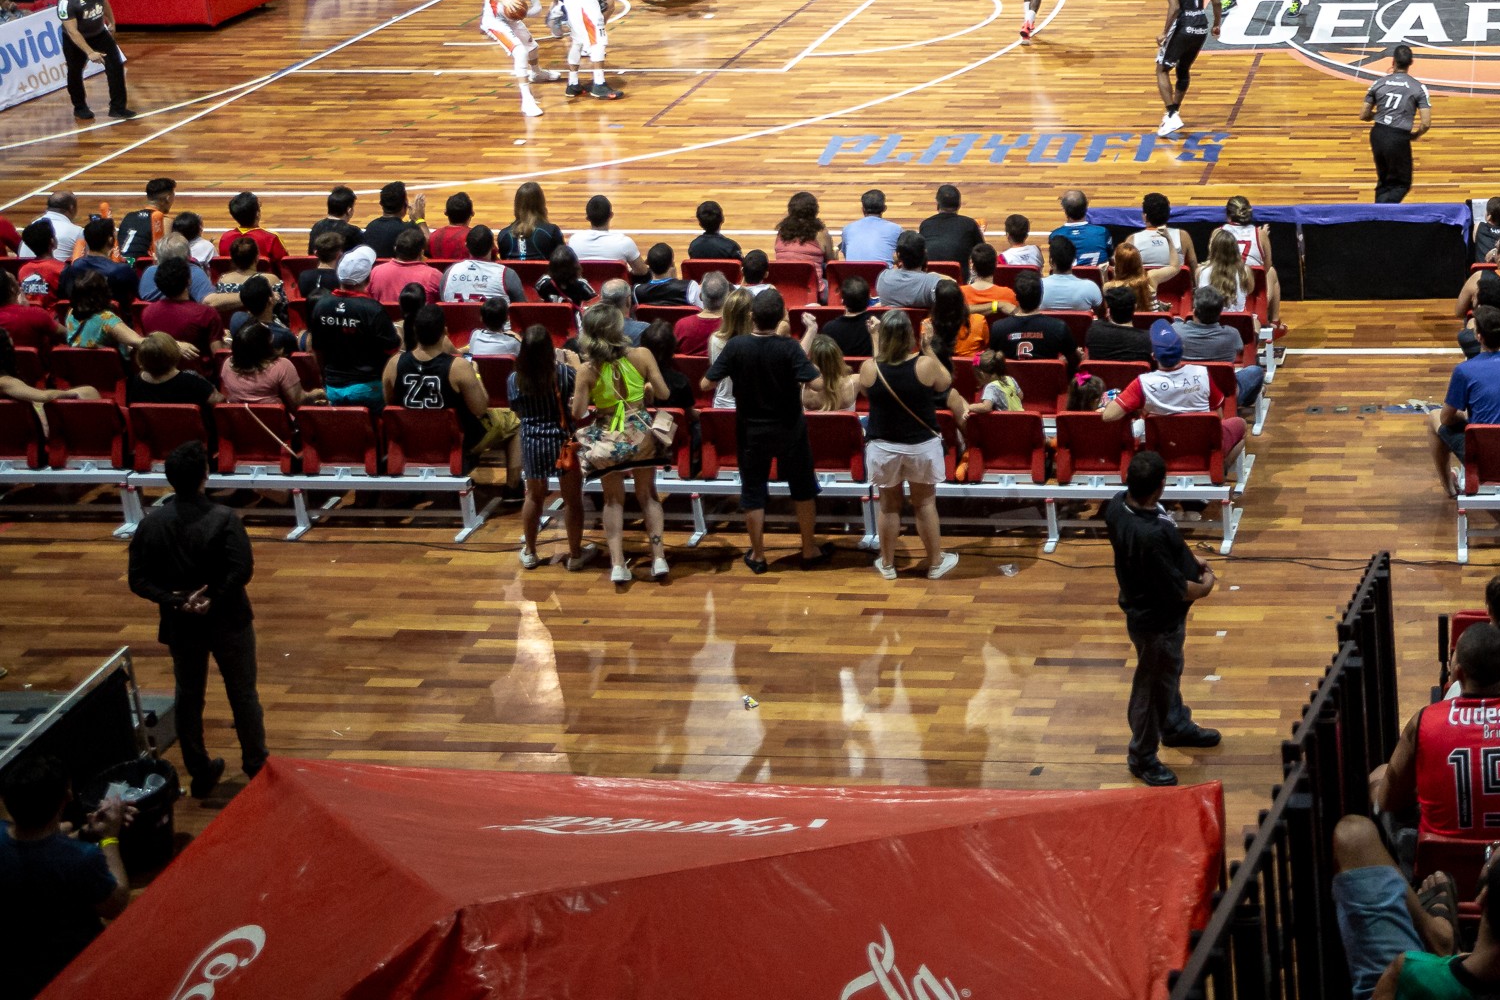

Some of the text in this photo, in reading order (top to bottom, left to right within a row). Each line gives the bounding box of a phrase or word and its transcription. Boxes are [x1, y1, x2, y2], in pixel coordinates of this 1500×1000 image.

[816, 132, 1230, 166] PLAYOFFS
[452, 274, 488, 282] SOLAR
[320, 316, 357, 327] SOLAR
[404, 374, 445, 410] 23
[1150, 375, 1201, 393] SOLAR
